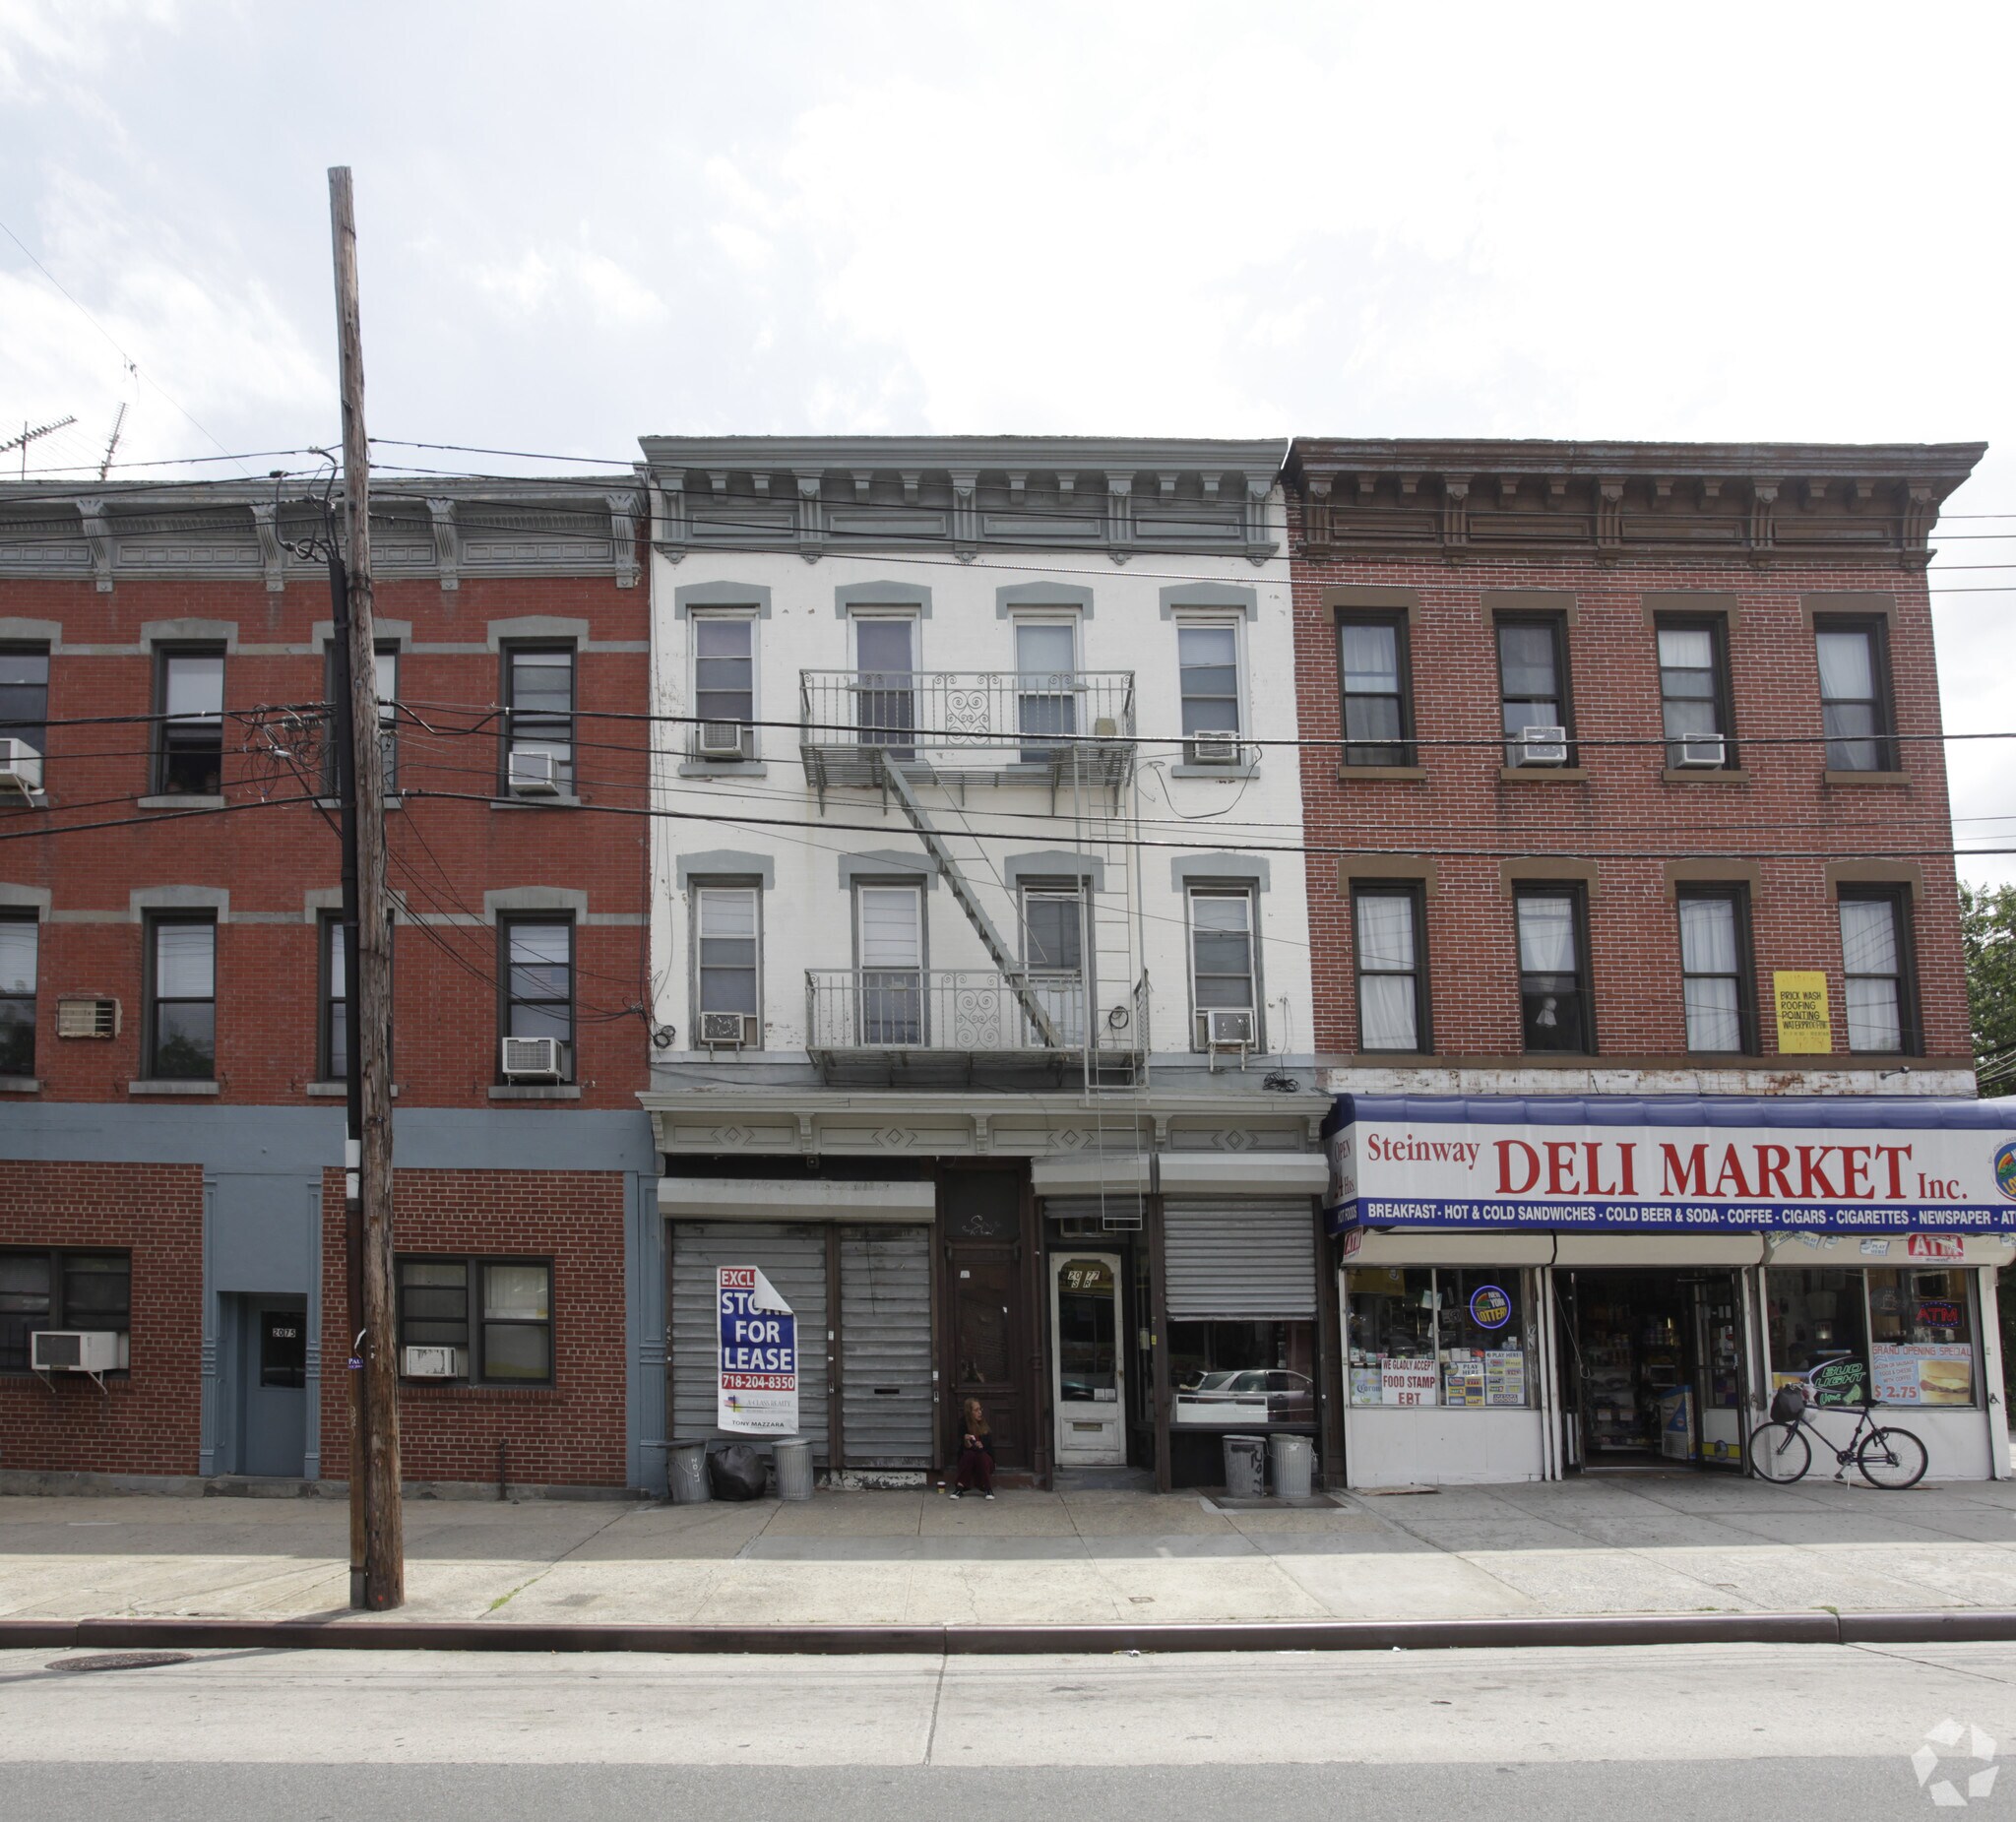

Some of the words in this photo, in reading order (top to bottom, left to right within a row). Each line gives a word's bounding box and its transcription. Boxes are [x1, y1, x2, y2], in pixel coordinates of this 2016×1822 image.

[1780, 991, 1800, 1001] BRICK
[1802, 991, 1822, 1001] WASH
[1781, 1001, 1816, 1010] ROOFING
[1782, 1011, 1820, 1020] POINTING
[1367, 1133, 1480, 1170] Steinway
[1492, 1139, 1640, 1196] DELI
[1659, 1142, 1913, 1200] MARKET
[1918, 1172, 1968, 1200] Inc.
[1444, 1205, 1470, 1220] HOT
[1472, 1205, 1480, 1220] &
[1482, 1205, 1515, 1220] COLD
[1518, 1206, 1596, 1221] SANDWICHES
[1606, 1207, 1639, 1222] COLD
[1641, 1207, 1672, 1223] BEER
[1674, 1208, 1683, 1223] &
[1727, 1209, 1773, 1224] COFFEE
[1782, 1209, 1827, 1225] CIGARS
[1836, 1210, 1910, 1225] CIGARETTES
[1919, 1210, 1991, 1225] NEWSPAPER
[2000, 1210, 2016, 1225] AT
[1914, 1234, 1959, 1256] ATM
[721, 1271, 755, 1286] EXCL
[1915, 1307, 1958, 1321] ATM
[274, 1328, 296, 1337] 2075
[735, 1320, 780, 1343] FOR
[1903, 1347, 1936, 1355] OPENING
[1939, 1348, 1971, 1356] SPECIAL
[724, 1347, 792, 1371] LEASE
[1383, 1359, 1392, 1369] WE
[1393, 1360, 1413, 1370] GLADLY
[1414, 1361, 1434, 1371] ACCEPT
[1822, 1363, 1862, 1378] BUD
[723, 1374, 794, 1390] 718-204-8350
[1383, 1375, 1405, 1388] FOOD
[1407, 1375, 1435, 1389] STAMP
[1814, 1372, 1866, 1389] LIGHT
[1356, 1383, 1382, 1394] Coron
[1874, 1384, 1881, 1399] $
[1886, 1386, 1917, 1398] 2.75
[1398, 1392, 1420, 1405] EBT
